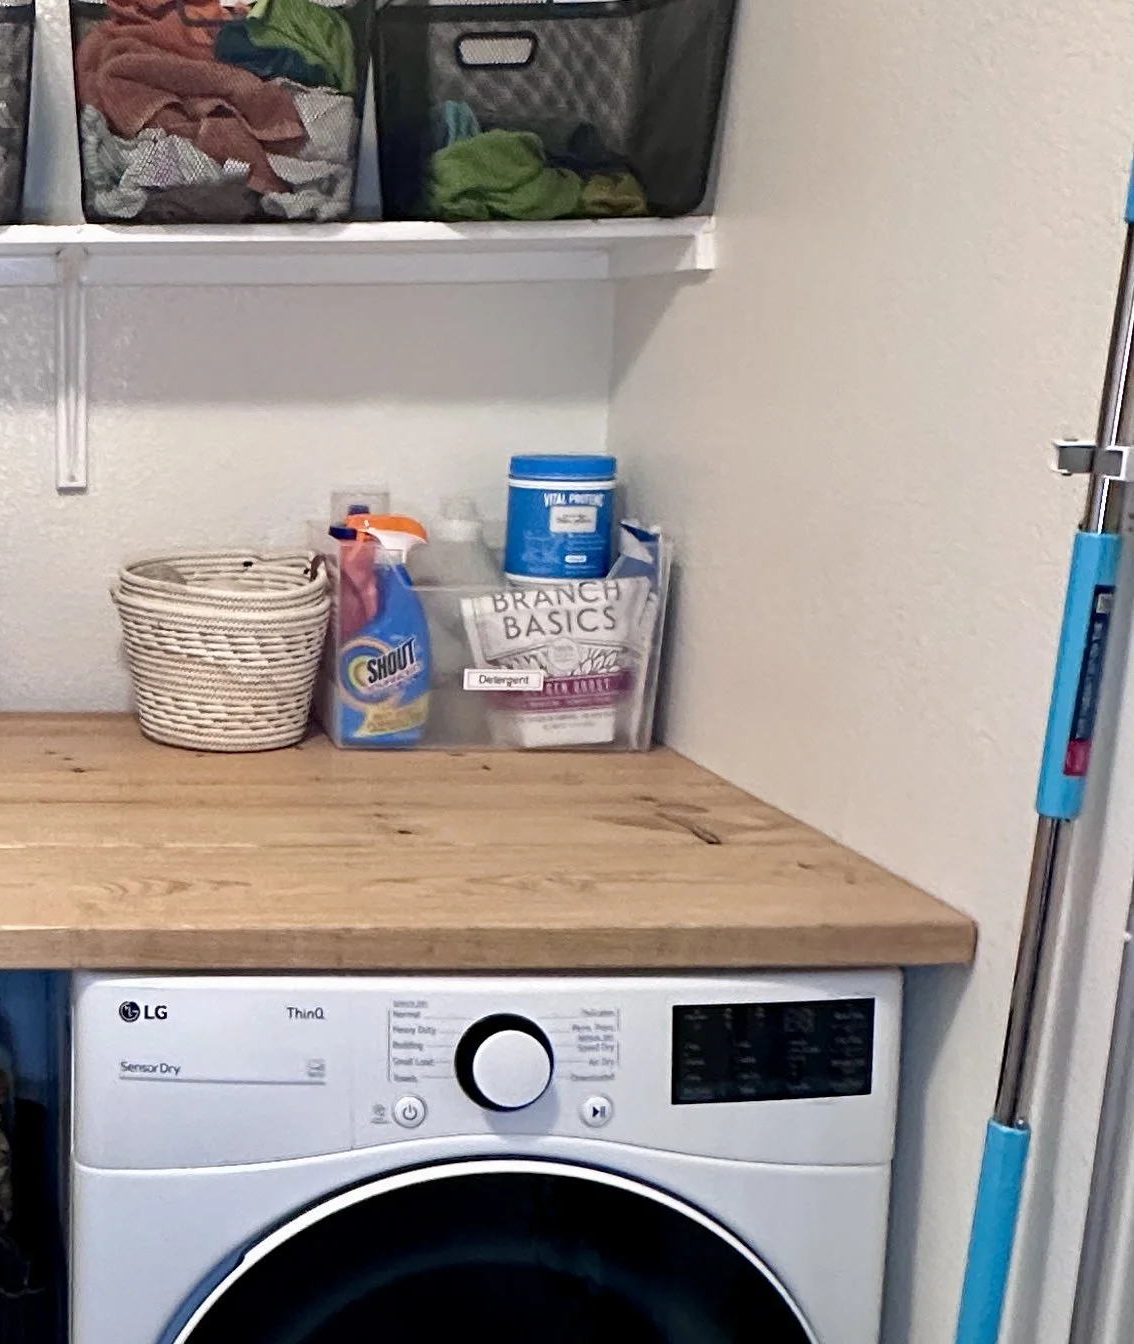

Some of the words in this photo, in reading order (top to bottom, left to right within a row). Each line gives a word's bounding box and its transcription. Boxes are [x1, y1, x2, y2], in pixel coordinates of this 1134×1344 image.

[544, 492, 566, 507] VITAL
[492, 581, 621, 613] BRANCH
[503, 606, 617, 640] BASICS
[367, 639, 415, 684] SHOUT
[479, 674, 530, 687] Detergent
[144, 1005, 168, 1020] LG
[287, 1006, 326, 1019] ThinQ
